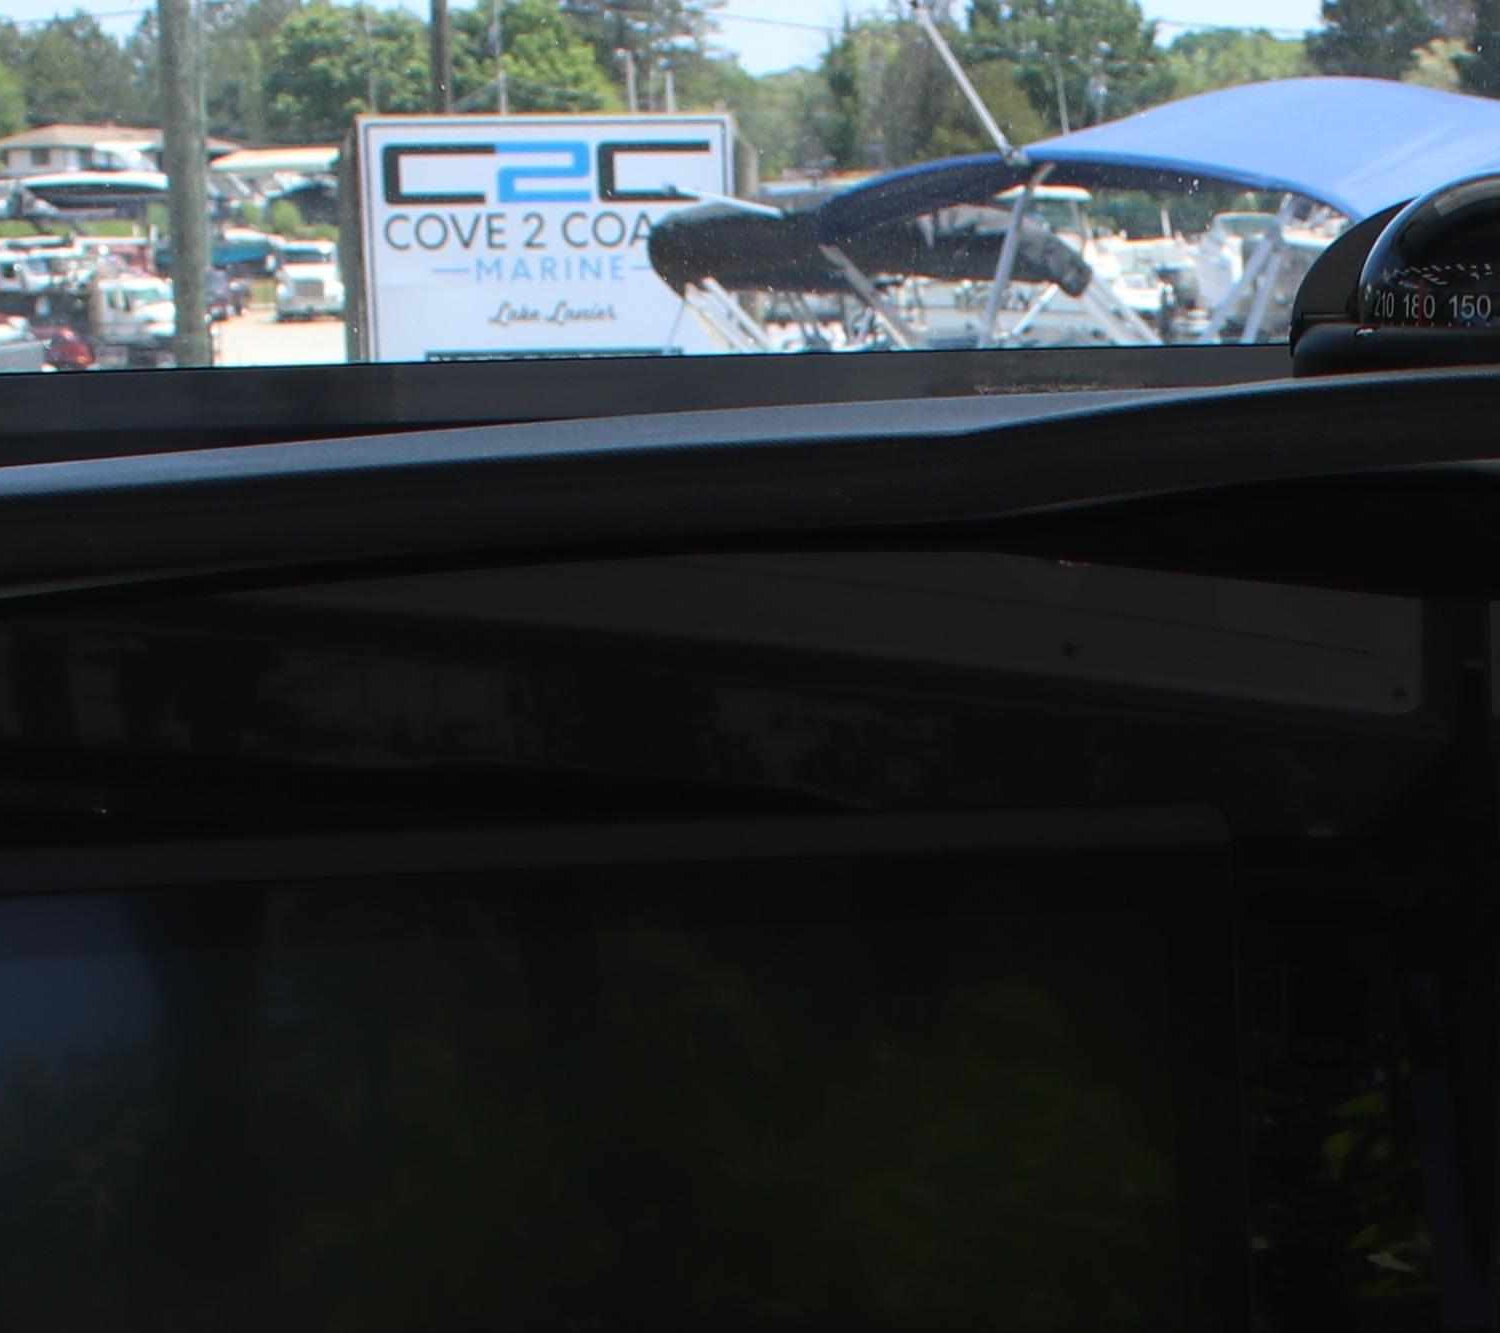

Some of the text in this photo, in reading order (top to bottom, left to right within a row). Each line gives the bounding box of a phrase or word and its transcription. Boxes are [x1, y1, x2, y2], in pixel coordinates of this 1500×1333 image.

[380, 140, 710, 204] C2C
[384, 212, 653, 250] COVE 2 COA
[475, 256, 625, 282] MARINE
[488, 301, 542, 327] Lake
[1374, 291, 1395, 317] 210
[1449, 295, 1492, 318] 150
